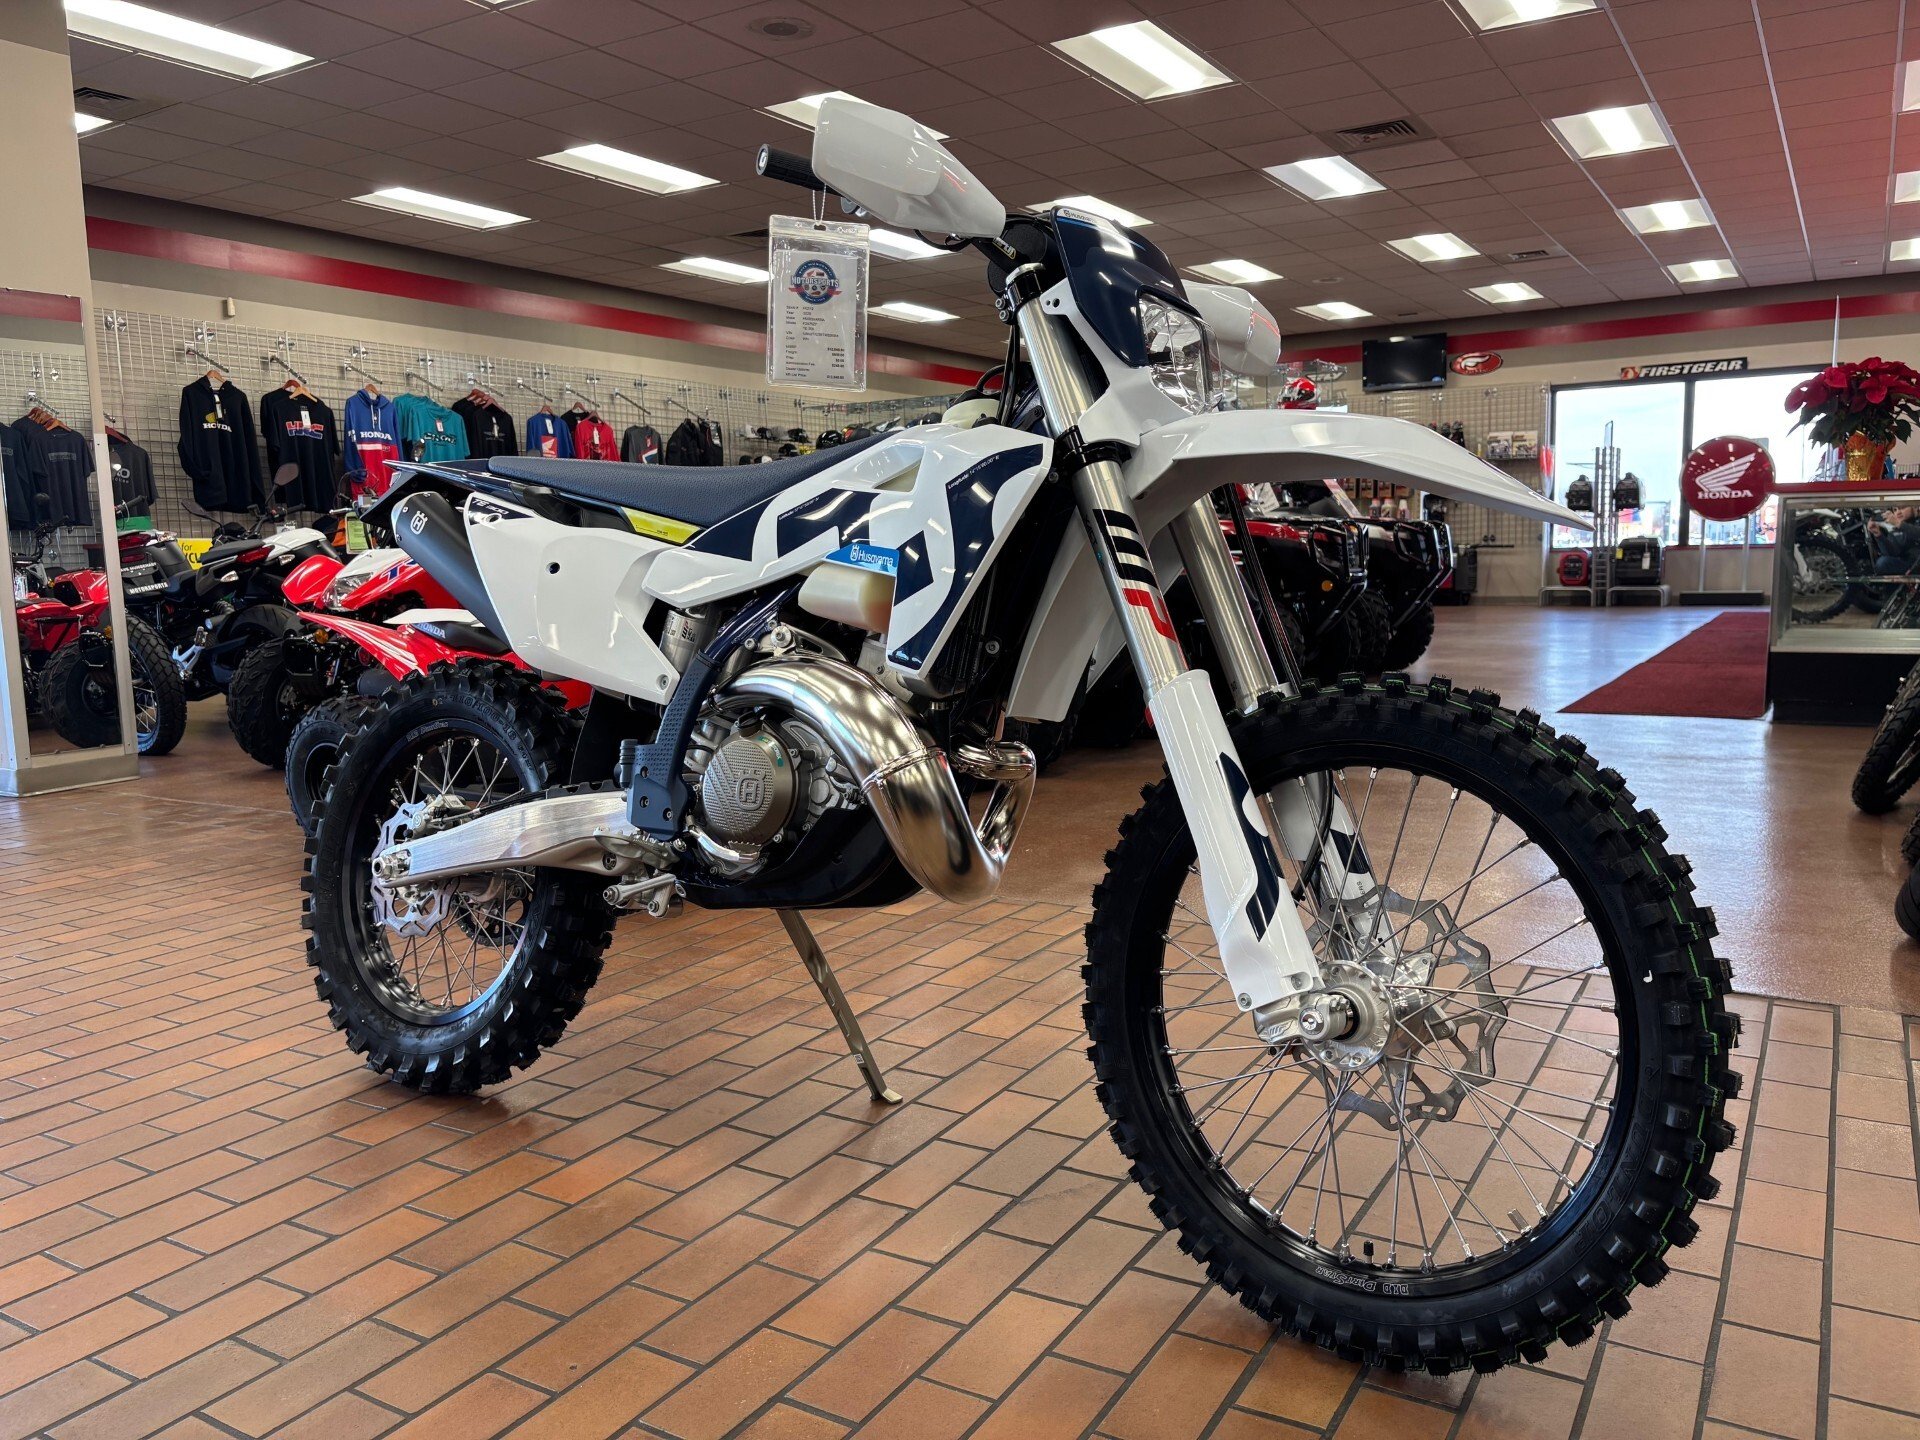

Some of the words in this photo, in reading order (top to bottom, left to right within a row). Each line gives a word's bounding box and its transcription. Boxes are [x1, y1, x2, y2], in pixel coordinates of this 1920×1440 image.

[790, 276, 840, 288] MOTORSPORTS
[1639, 359, 1744, 378] FIRSTGEAR
[360, 431, 393, 441] HONDA
[1697, 489, 1754, 500] HONDA
[181, 542, 193, 552] for
[858, 549, 894, 567] Husqvarna
[129, 582, 169, 595] MOTORSPORTS
[1383, 1282, 1410, 1296] DID
